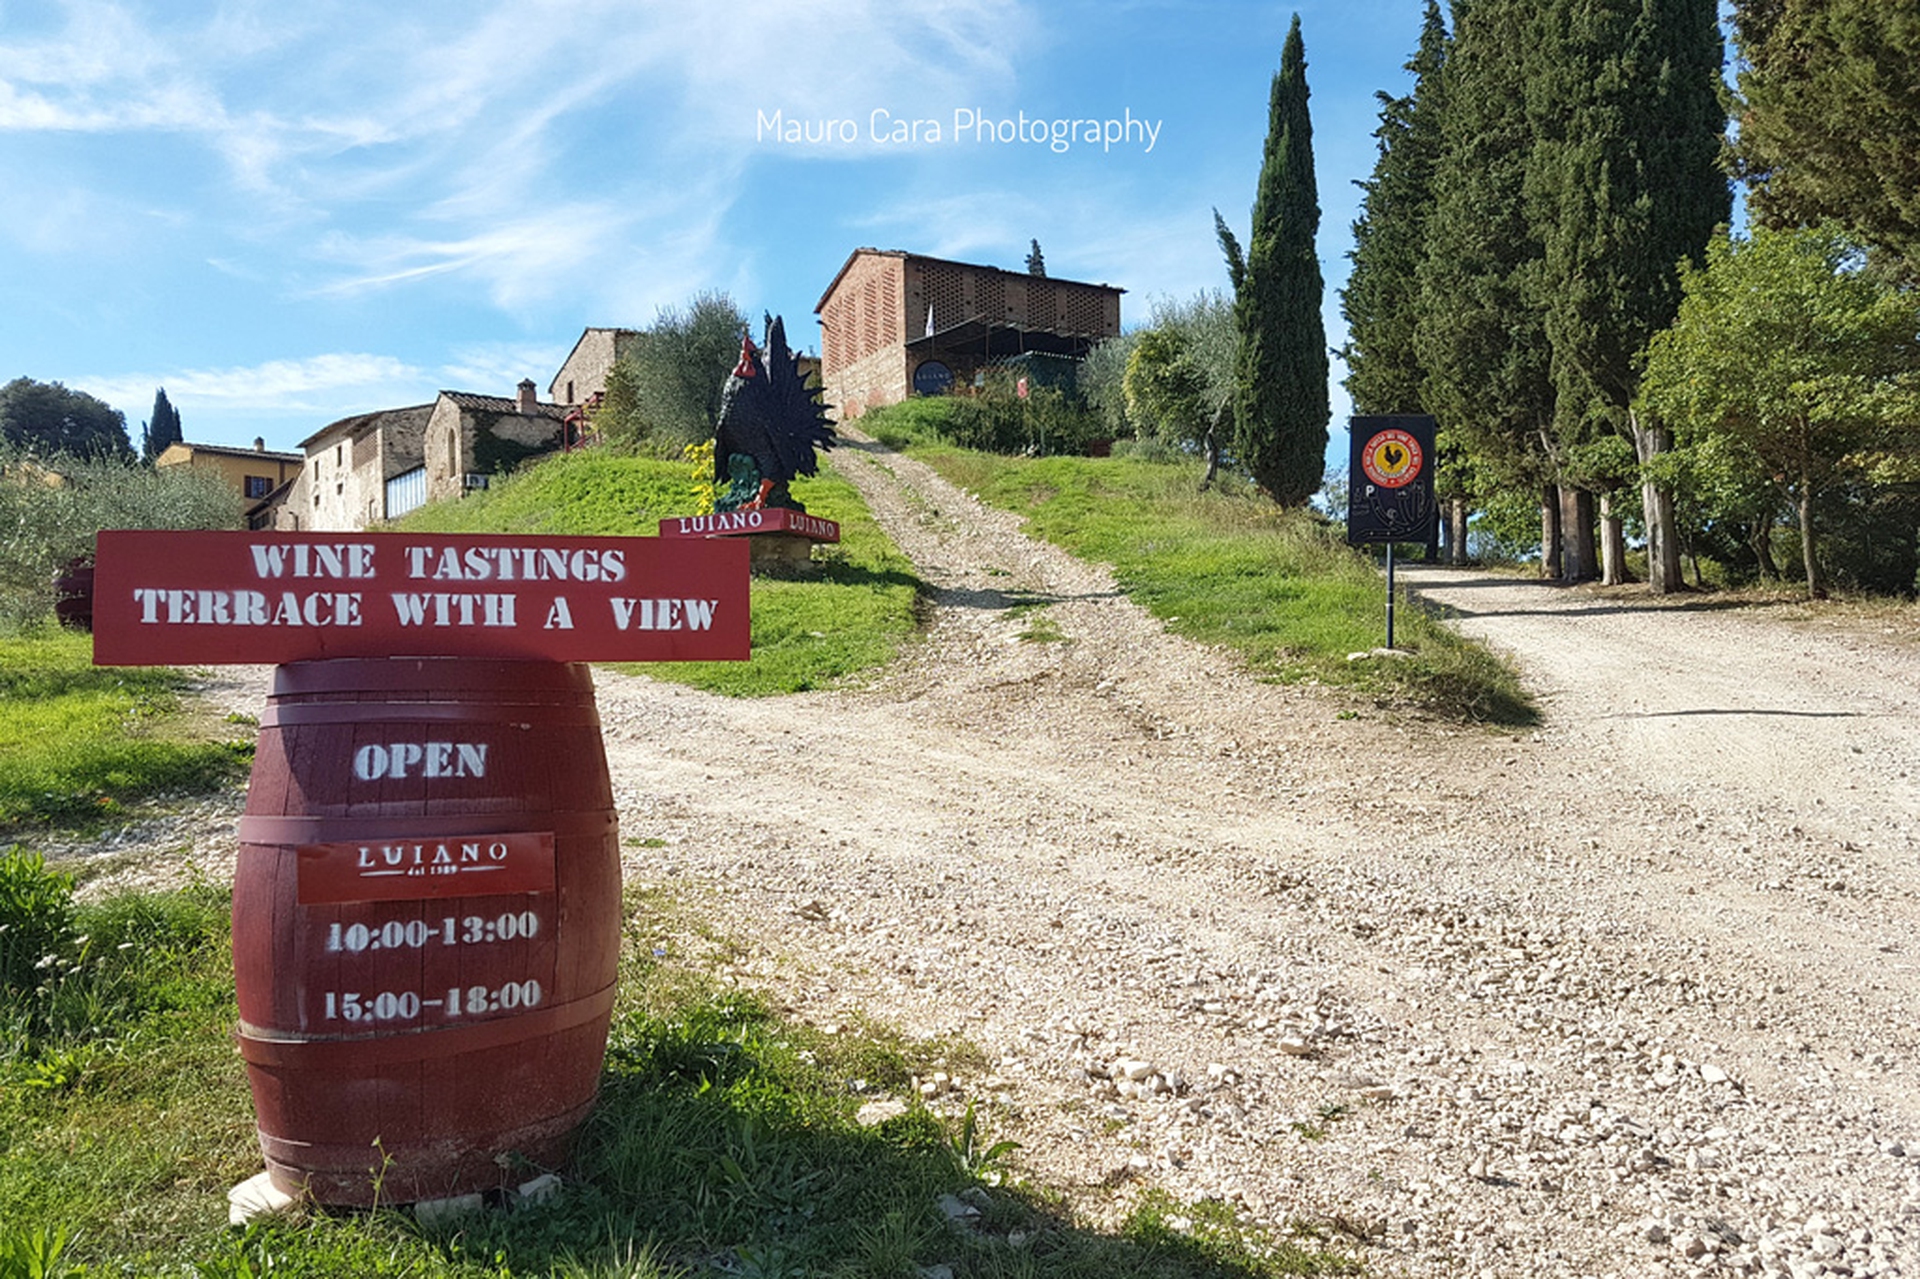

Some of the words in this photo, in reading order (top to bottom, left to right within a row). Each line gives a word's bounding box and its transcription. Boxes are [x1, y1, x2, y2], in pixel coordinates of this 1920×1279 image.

[1365, 485, 1375, 497] P
[679, 511, 763, 534] LUIANO
[789, 513, 835, 537] LUIANO
[250, 544, 376, 579] WINE
[404, 546, 626, 583] TASTINGS
[133, 588, 363, 627] TERRACE
[391, 593, 517, 627] WITH
[543, 596, 574, 629] A
[609, 597, 719, 631] VIEW
[353, 742, 488, 781] OPEN
[358, 842, 508, 867] LUIANO
[327, 911, 539, 952] 10:00-13:00
[324, 979, 541, 1021] 15:00-18:00
